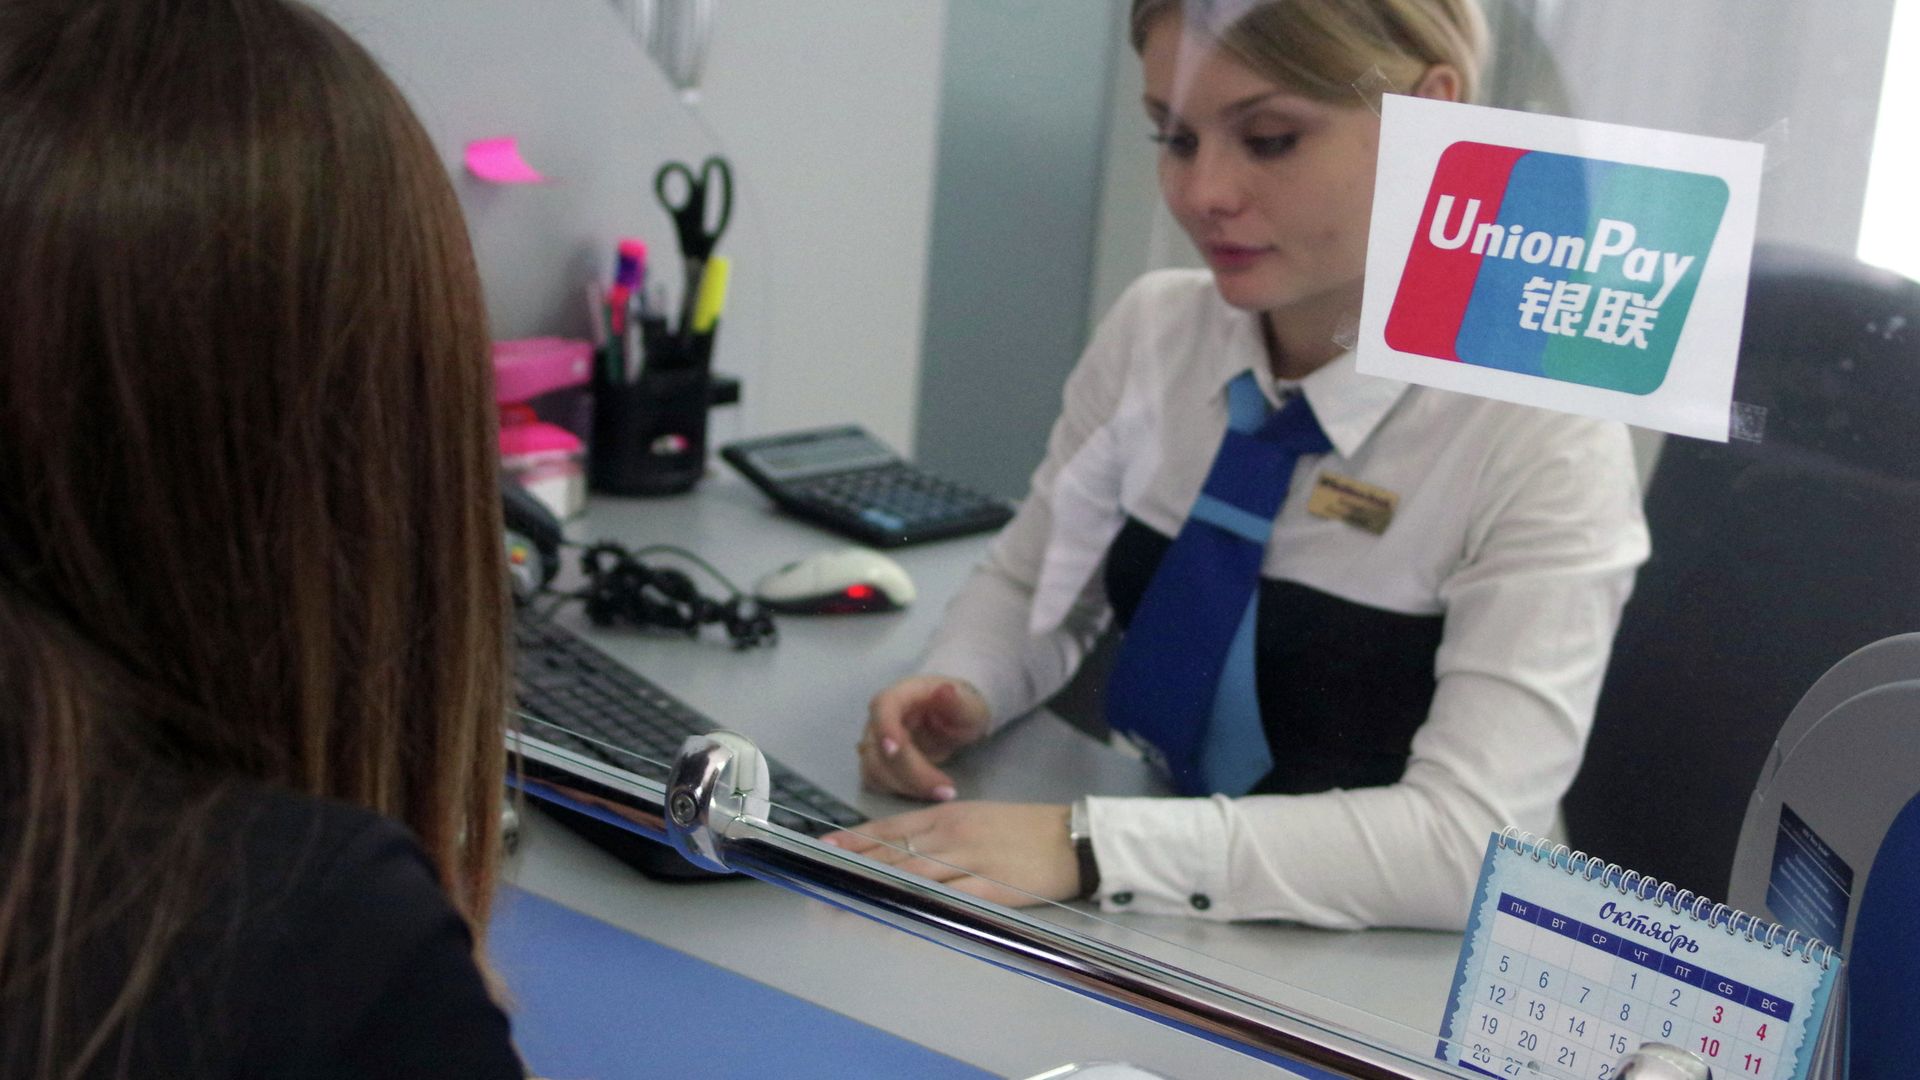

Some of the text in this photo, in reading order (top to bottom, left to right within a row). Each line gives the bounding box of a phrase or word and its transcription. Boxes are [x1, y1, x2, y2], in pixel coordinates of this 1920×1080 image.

[1428, 194, 1695, 309] UnionPay
[1518, 276, 1660, 350] 银联
[1510, 902, 1778, 1012] ПН ВТ СР ЧТ ПТ СБ ВС
[1599, 901, 1699, 954] Октябрь
[1481, 1014, 1498, 1035] 19
[1517, 1030, 1538, 1051] 20
[1557, 1046, 1577, 1068] 21
[1488, 984, 1627, 1054] 12 13 14 15
[1499, 955, 1762, 1075] 5 6 7 8 9 10 11
[1630, 972, 1768, 1041] 1 2 3 4
